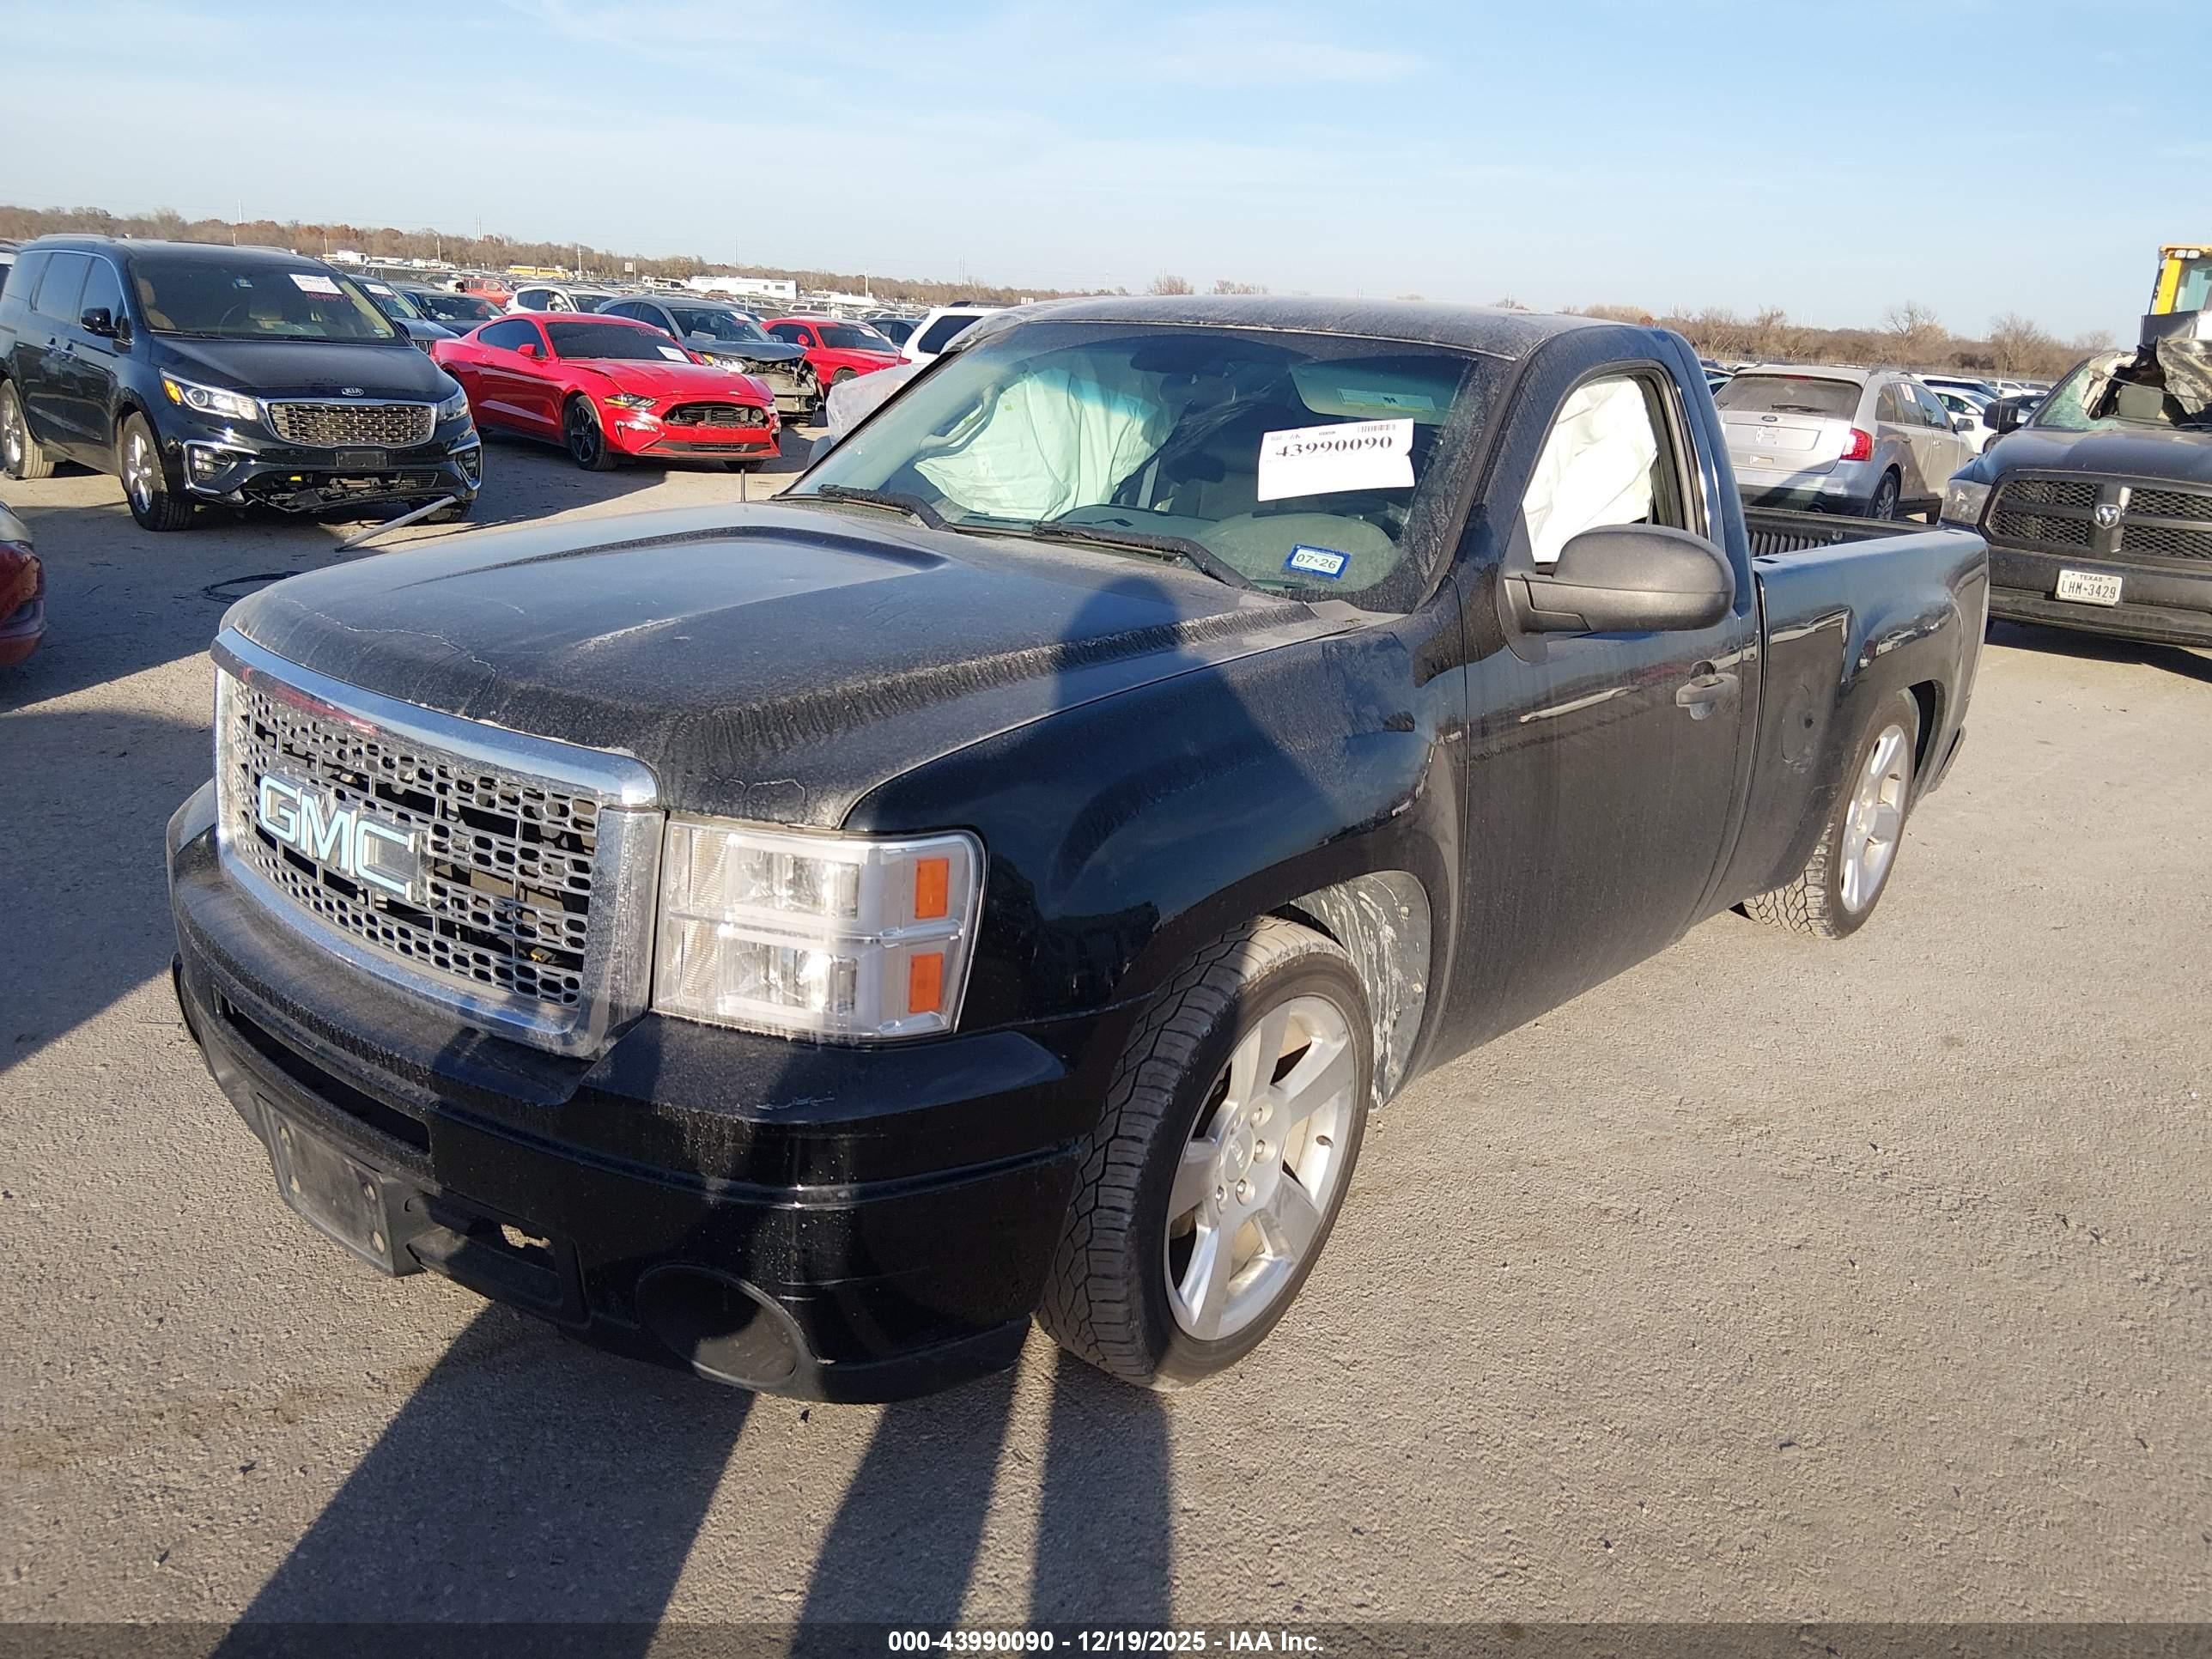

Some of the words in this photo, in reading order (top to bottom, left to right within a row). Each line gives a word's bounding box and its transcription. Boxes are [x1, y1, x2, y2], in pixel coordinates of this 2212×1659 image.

[1276, 435, 1393, 458] 43990090
[2079, 574, 2103, 582] TEXAS
[259, 774, 416, 904] GMC
